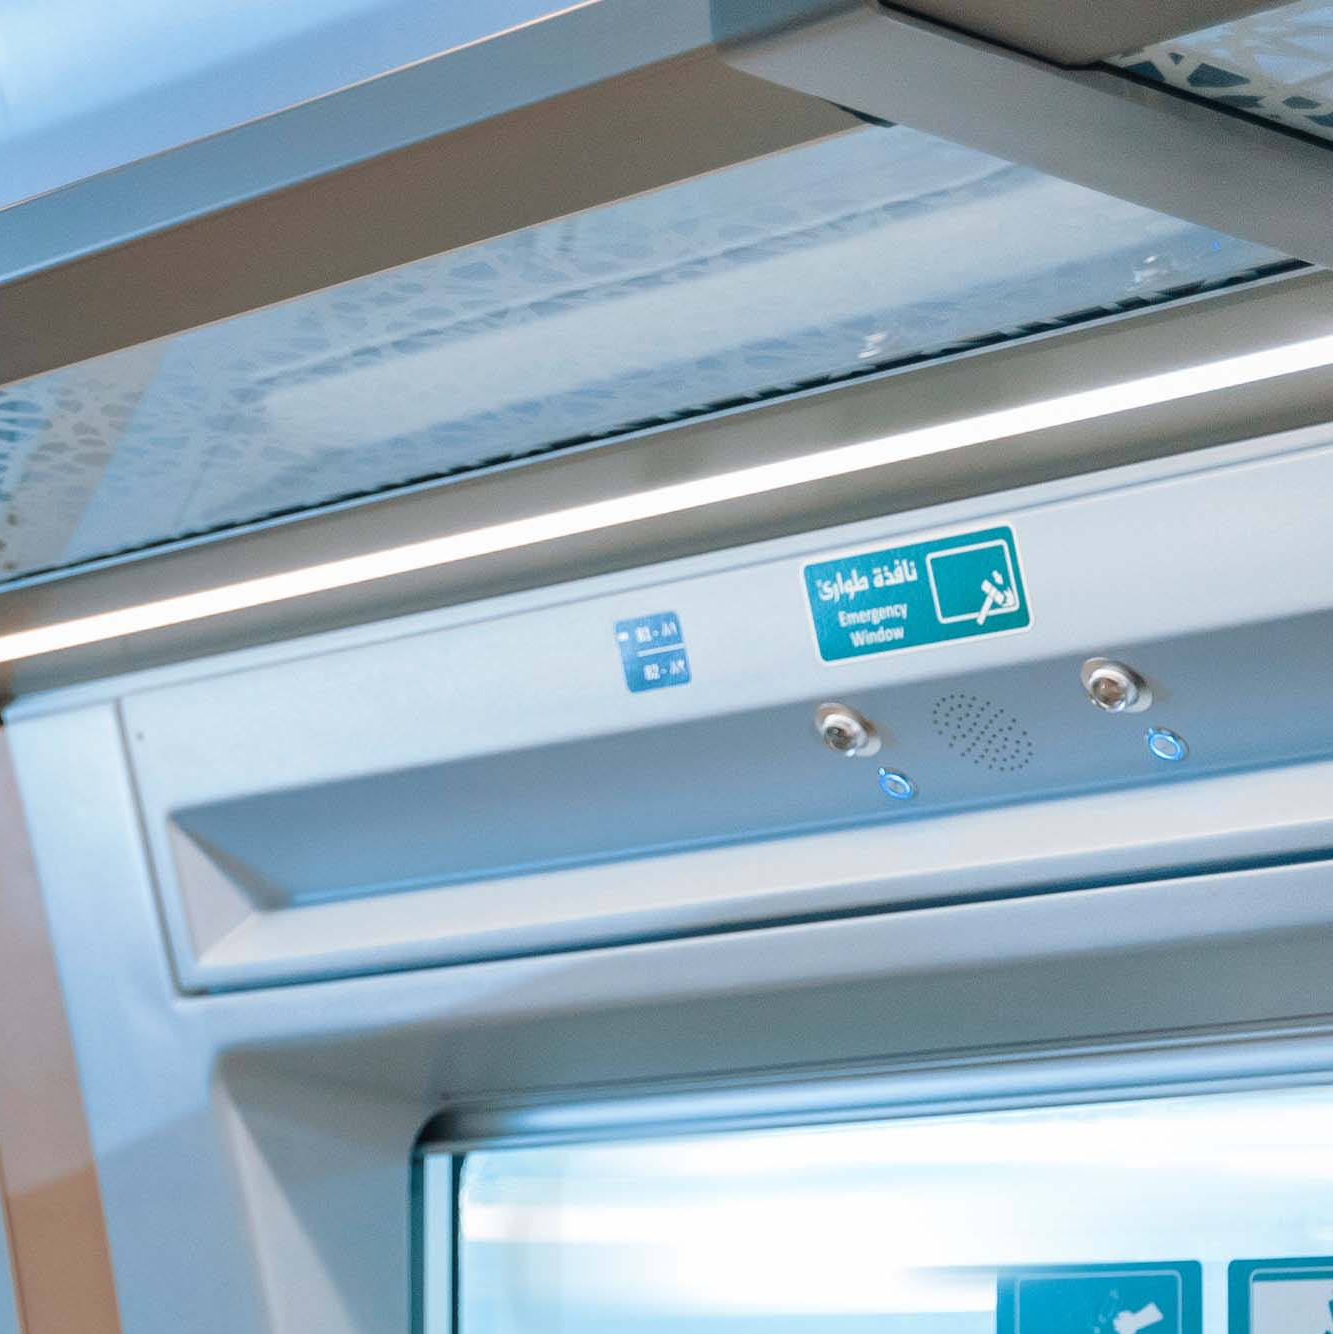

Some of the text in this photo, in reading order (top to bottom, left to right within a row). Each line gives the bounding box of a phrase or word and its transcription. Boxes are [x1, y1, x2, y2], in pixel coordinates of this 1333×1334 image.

[872, 558, 918, 588] نافذة
[838, 603, 908, 627] Emergency
[850, 625, 905, 647] Window
